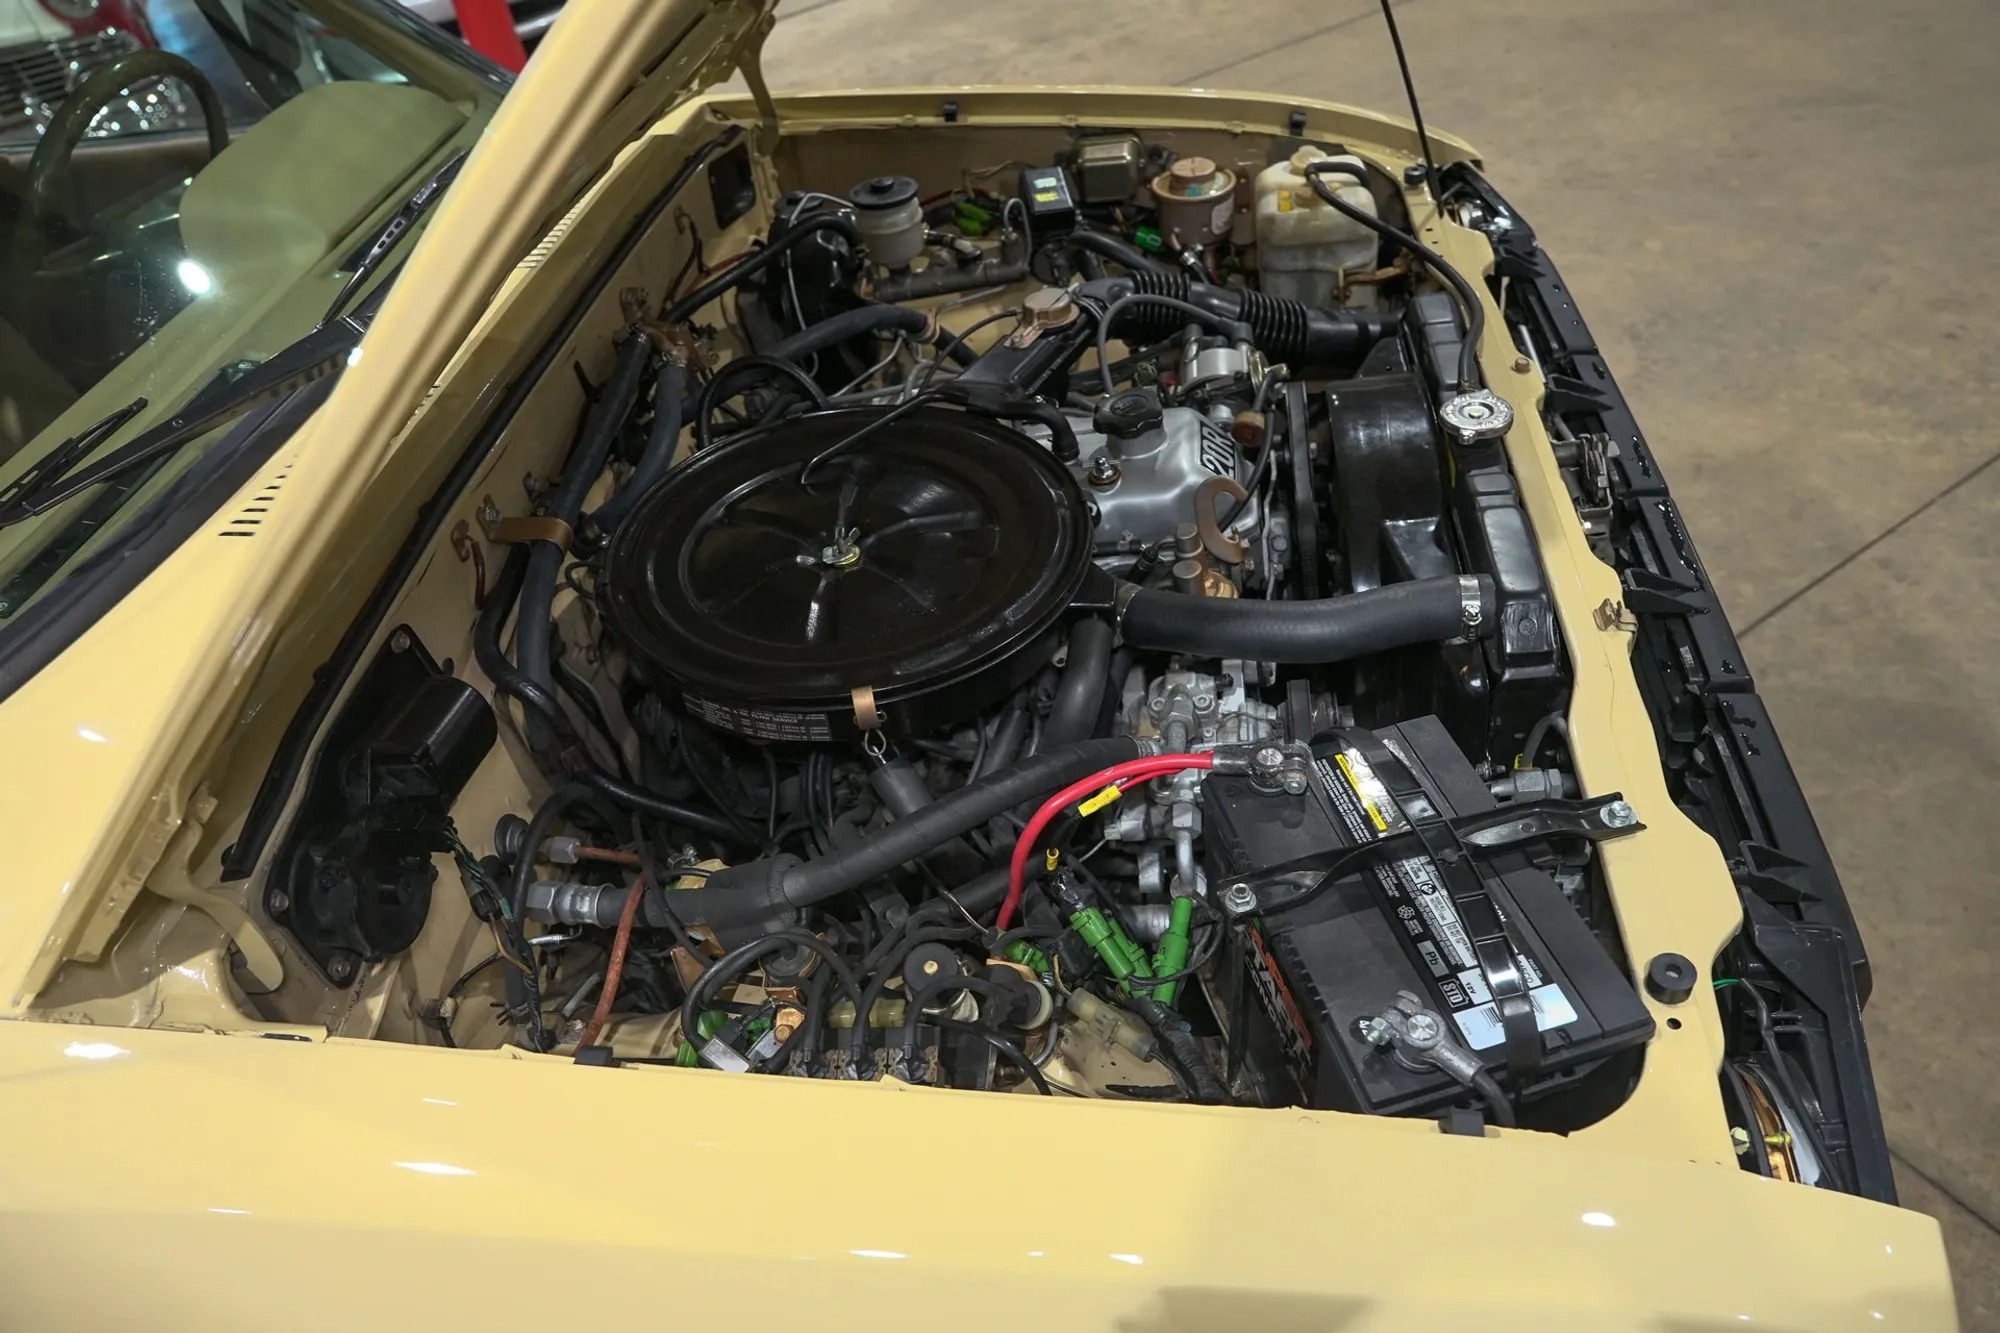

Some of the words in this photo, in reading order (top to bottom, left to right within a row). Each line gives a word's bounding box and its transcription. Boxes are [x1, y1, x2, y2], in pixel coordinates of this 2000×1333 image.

[1202, 426, 1235, 478] 20R
[1425, 951, 1438, 966] Pb
[1443, 982, 1463, 1006] STD
[1465, 982, 1476, 994] 12V
